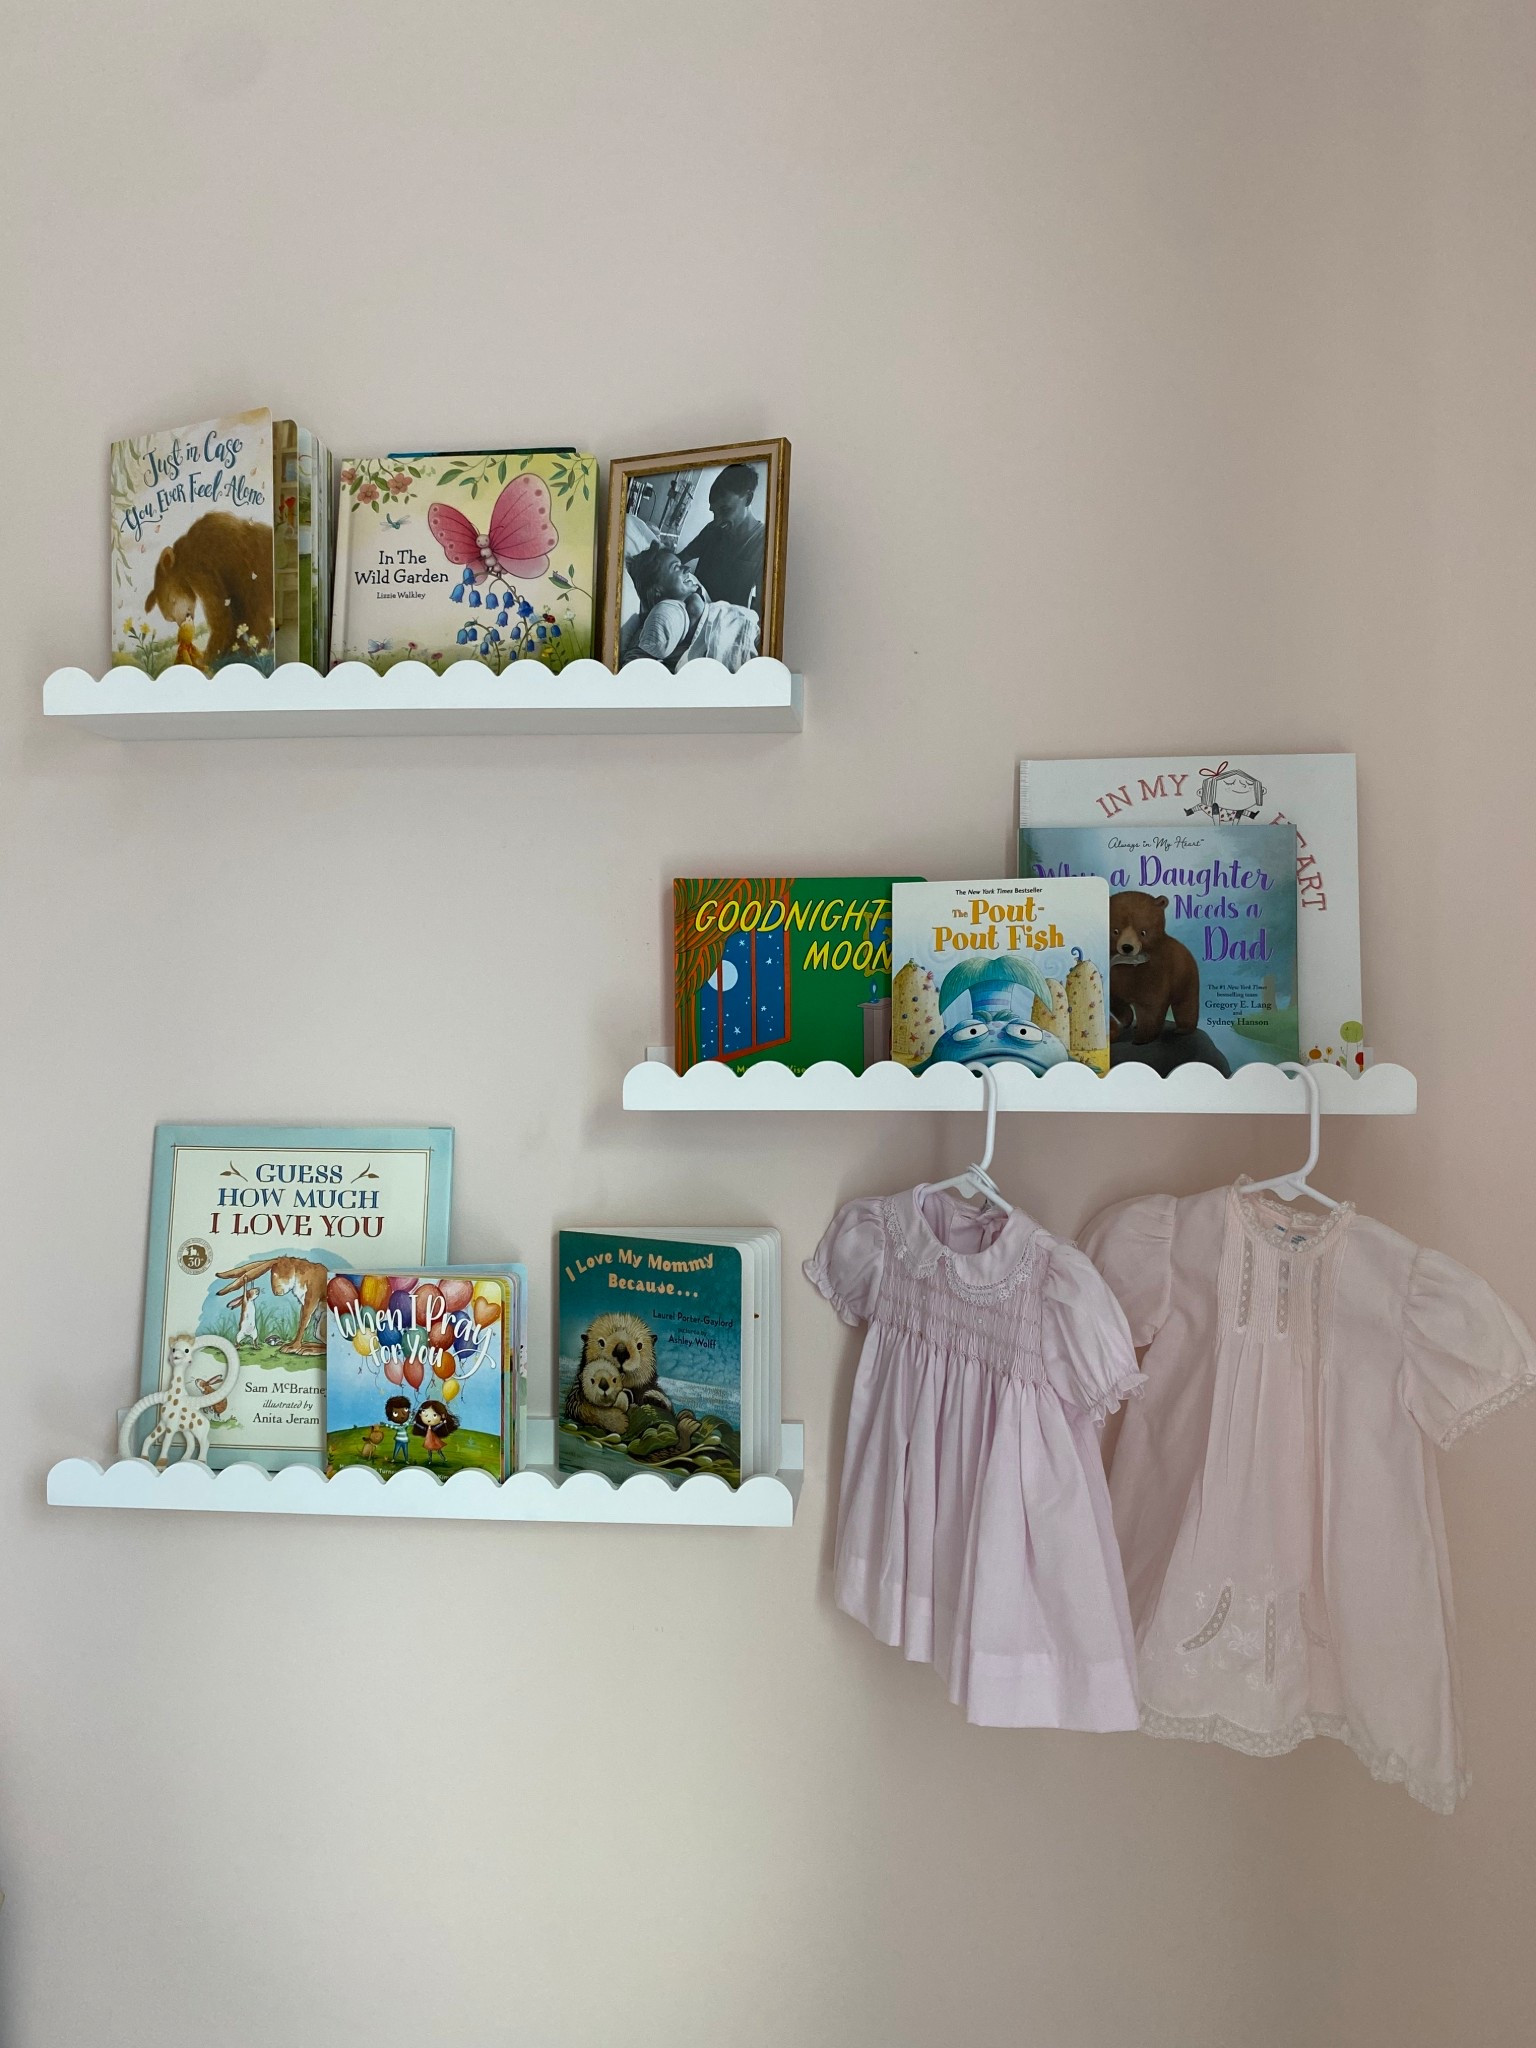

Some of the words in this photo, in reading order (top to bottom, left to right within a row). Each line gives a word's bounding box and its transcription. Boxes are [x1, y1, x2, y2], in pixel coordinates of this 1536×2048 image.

[143, 438, 183, 488] Just
[186, 443, 200, 462] in
[204, 430, 243, 469] Case
[120, 503, 163, 542] You
[188, 469, 222, 503] Feel
[224, 474, 265, 507] Alone
[378, 550, 394, 565] In
[396, 549, 427, 565] The
[354, 569, 390, 586] Wild
[393, 568, 450, 585] Garden
[376, 591, 397, 600] Lizzie
[397, 590, 426, 600] Walkley
[1095, 784, 1134, 818] IN
[1137, 773, 1189, 801] MY
[1107, 836, 1140, 853] Always
[1143, 840, 1152, 848] in
[1152, 836, 1172, 852] My
[1174, 835, 1201, 850] Heart
[1109, 865, 1131, 888] a
[1138, 854, 1275, 898] Daughter
[694, 898, 892, 933] GOODNIGHT
[951, 909, 968, 919] The
[968, 896, 1045, 926] Pout-
[1173, 893, 1239, 920] Needs
[1245, 901, 1264, 920] a
[931, 924, 1000, 953] Pout
[1005, 923, 1066, 952] Fish
[1201, 925, 1274, 962] Dad
[802, 940, 893, 971] MOON
[1204, 1000, 1238, 1011] Gregory
[1240, 1000, 1249, 1009] E.
[1251, 1000, 1272, 1011] Lang
[1206, 1017, 1235, 1028] Sydney
[1237, 1017, 1269, 1026] Hanson
[255, 1163, 343, 1184] GUESS
[216, 1187, 286, 1208] HOW
[293, 1188, 380, 1210] MUCH
[209, 1212, 221, 1235] I
[230, 1213, 313, 1237] LOVE
[319, 1215, 385, 1238] YOU
[565, 1266, 576, 1282] I
[575, 1252, 613, 1274] Love
[618, 1248, 643, 1269] My
[647, 1252, 714, 1273] Mommy
[652, 1309, 675, 1320] Laurel
[333, 1297, 403, 1340] When
[408, 1294, 419, 1331] I
[426, 1294, 497, 1380] Pray
[668, 1334, 693, 1348] Ashley
[695, 1337, 717, 1349] Wolff
[368, 1336, 402, 1367] for
[406, 1334, 443, 1368] You
[244, 1381, 268, 1393] Sam
[271, 1382, 327, 1398] McBratne
[252, 1412, 283, 1424] Anita
[285, 1413, 320, 1425] Jeram
[262, 1399, 303, 1409] illustrated
[303, 1400, 314, 1412] by
